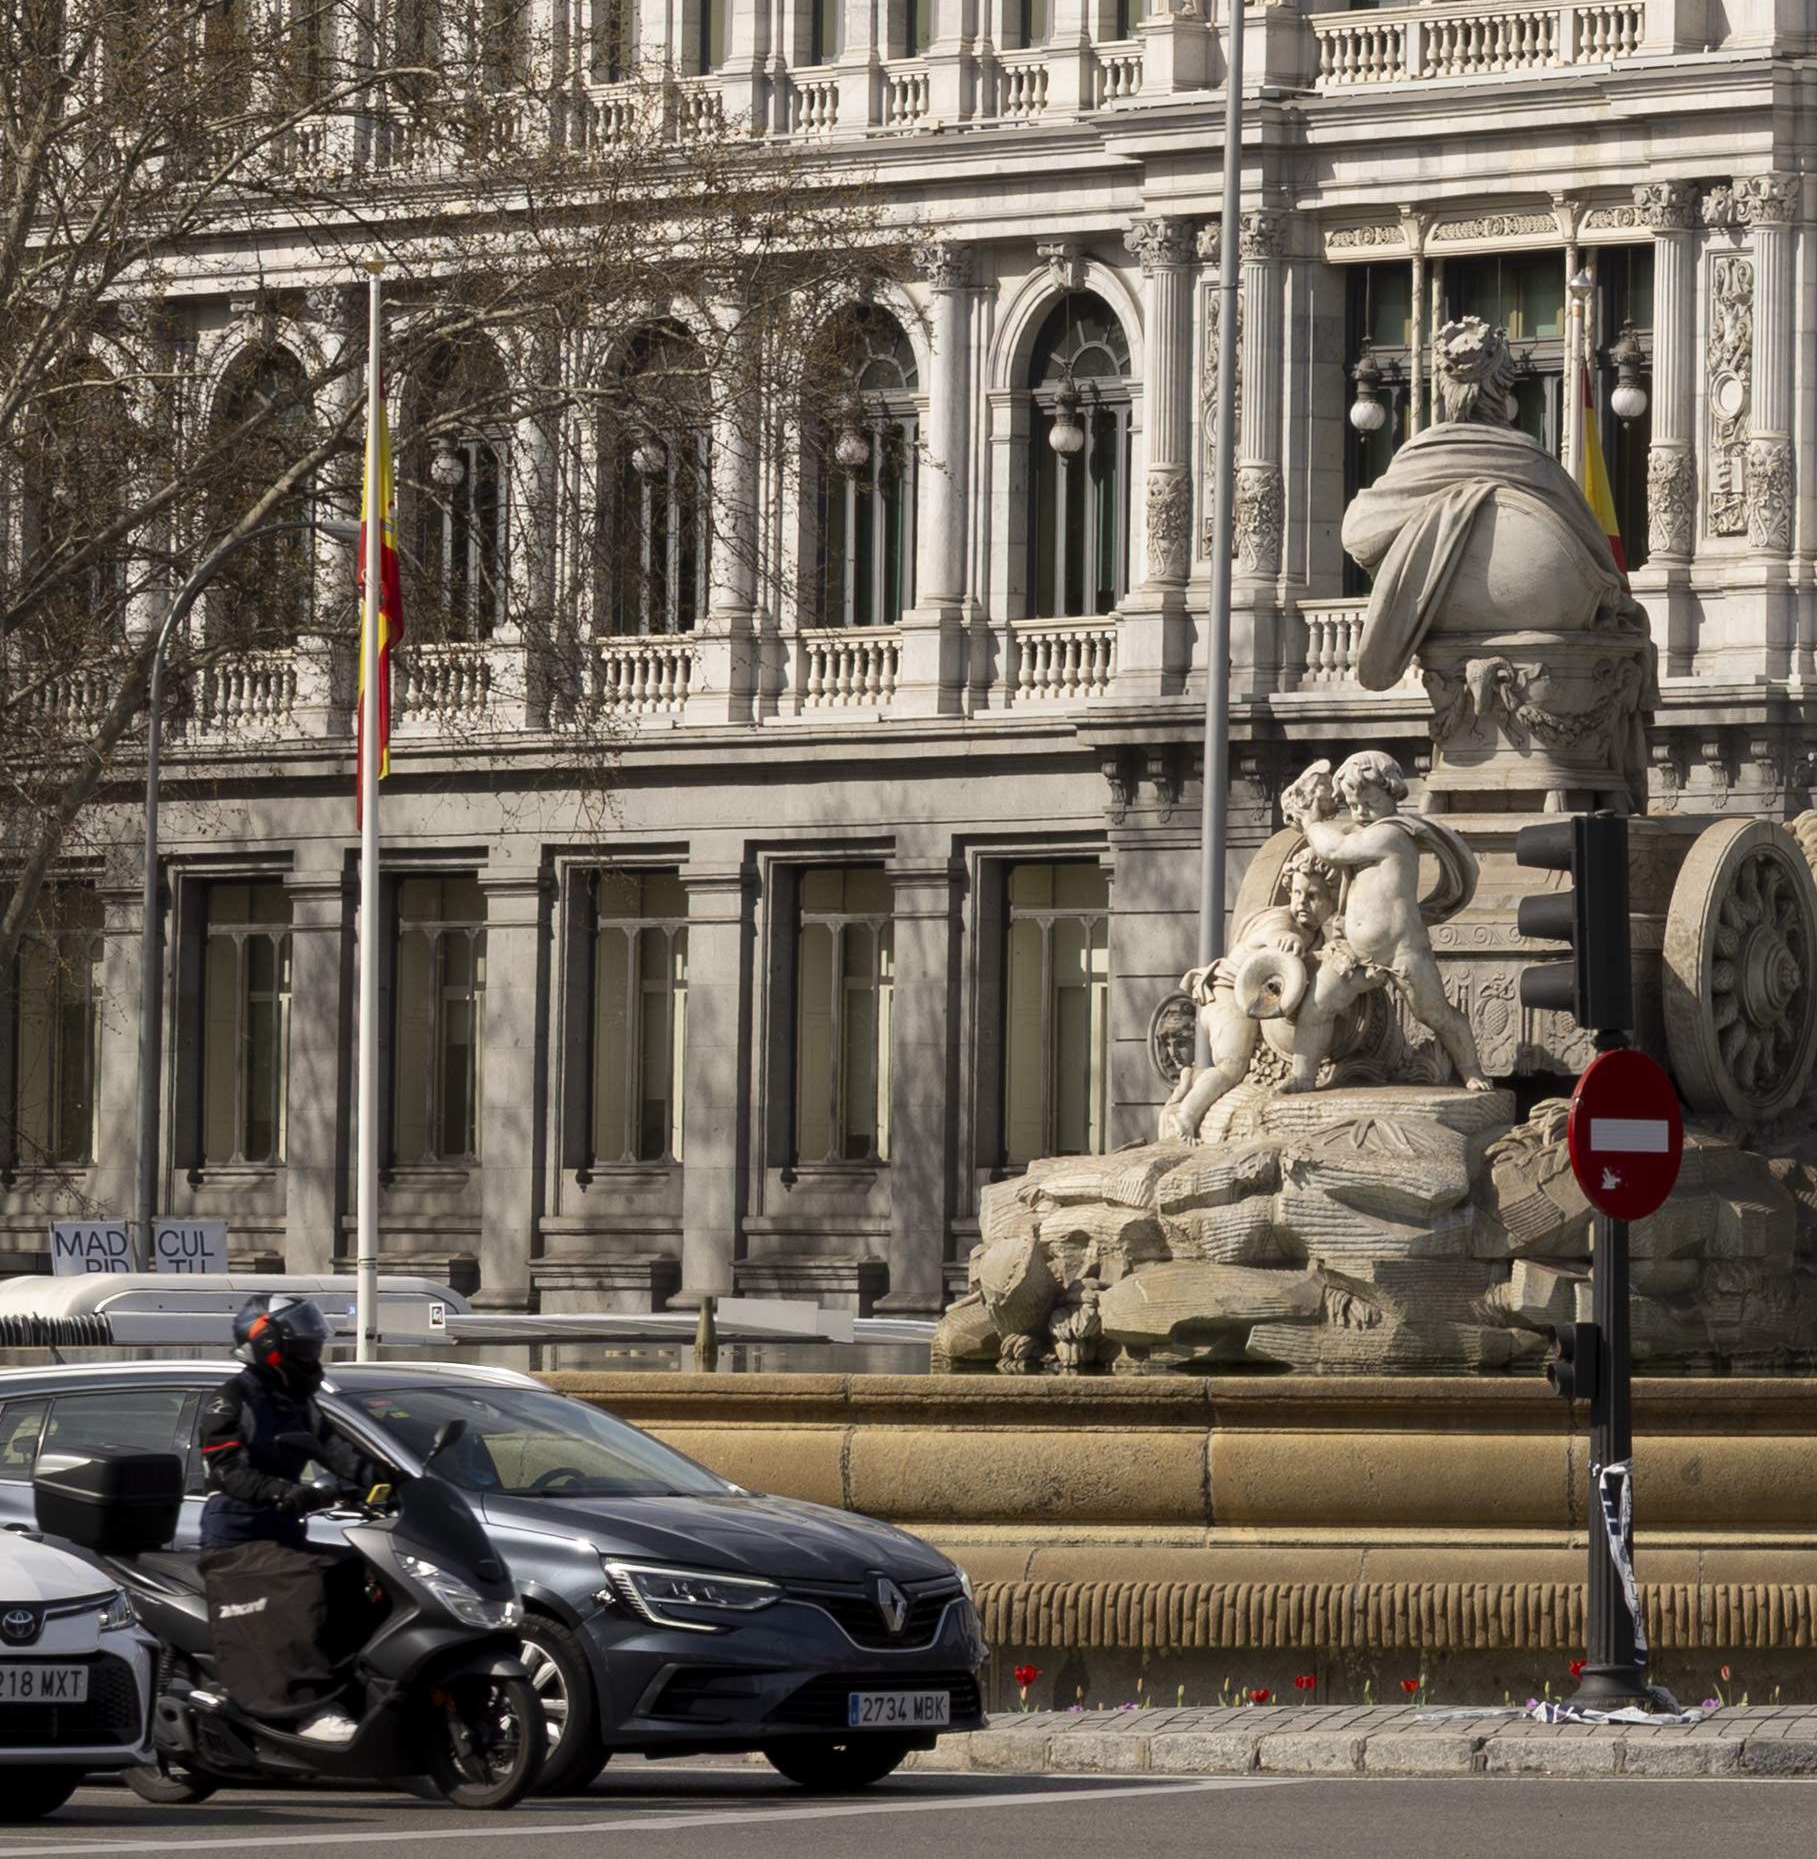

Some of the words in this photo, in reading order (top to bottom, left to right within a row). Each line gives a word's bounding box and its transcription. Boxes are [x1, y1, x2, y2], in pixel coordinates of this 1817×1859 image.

[55, 1230, 127, 1257] MAD
[158, 1229, 214, 1257] CUL
[41, 1670, 83, 1697] MXT
[862, 1696, 907, 1722] 2734
